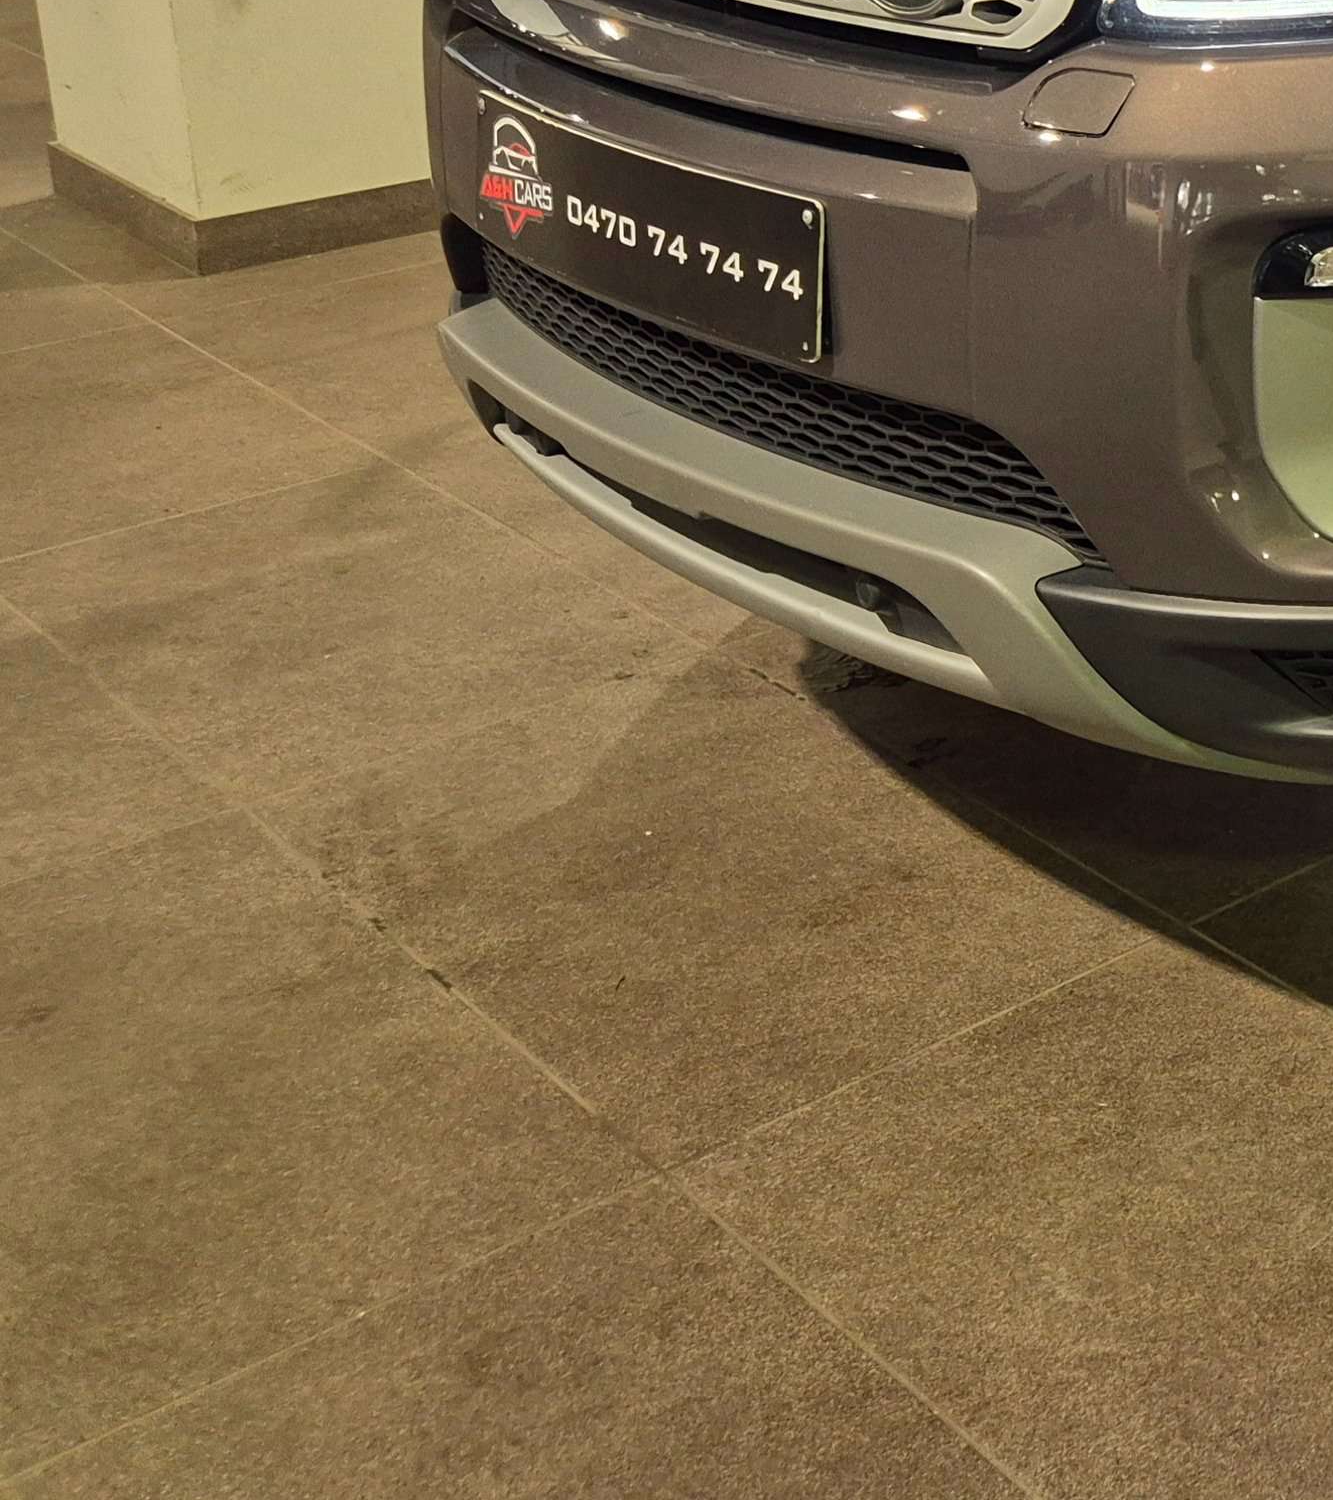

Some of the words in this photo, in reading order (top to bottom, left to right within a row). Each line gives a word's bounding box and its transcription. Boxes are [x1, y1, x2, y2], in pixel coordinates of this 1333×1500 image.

[566, 194, 636, 248] 0470
[647, 224, 688, 265] 74
[699, 241, 744, 283] 74
[757, 258, 804, 301] 74
